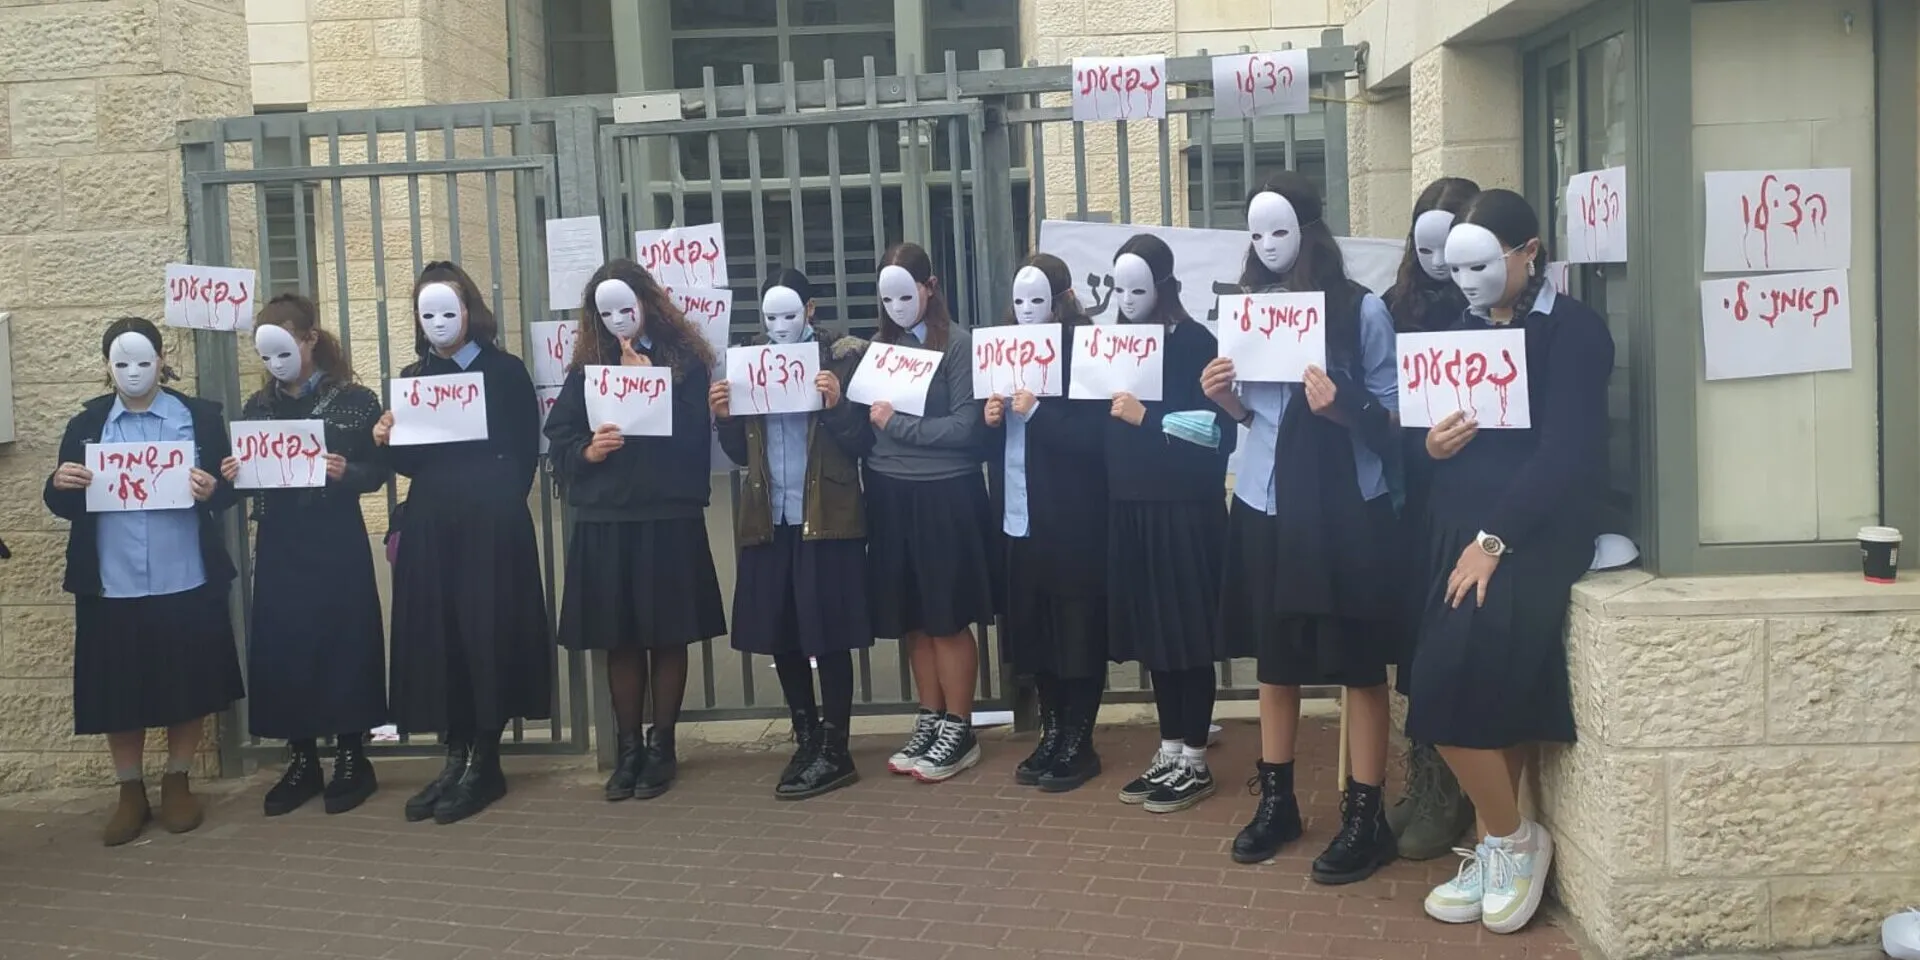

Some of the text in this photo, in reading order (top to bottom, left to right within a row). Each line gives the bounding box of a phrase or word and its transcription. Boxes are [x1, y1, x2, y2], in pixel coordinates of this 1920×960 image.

[1077, 65, 1160, 99] נפגעתי
[1236, 56, 1293, 97] הצילו
[1580, 175, 1620, 230] הצילו
[1741, 175, 1827, 236] הצילו
[642, 236, 719, 272] נפגעתי
[170, 274, 248, 308] נפגעתי
[1723, 280, 1749, 321] לי
[1234, 297, 1253, 332] לי
[874, 347, 894, 369] לי
[977, 338, 1055, 373] נפגעתי
[1085, 328, 1102, 358] לי
[594, 368, 610, 396] לי
[749, 349, 804, 390] הצילו
[1403, 347, 1517, 393] נפגעתי
[404, 380, 421, 406] לי
[99, 446, 184, 475] תשמרו
[237, 431, 321, 465] נפגעתי
[108, 473, 149, 503] עלי
